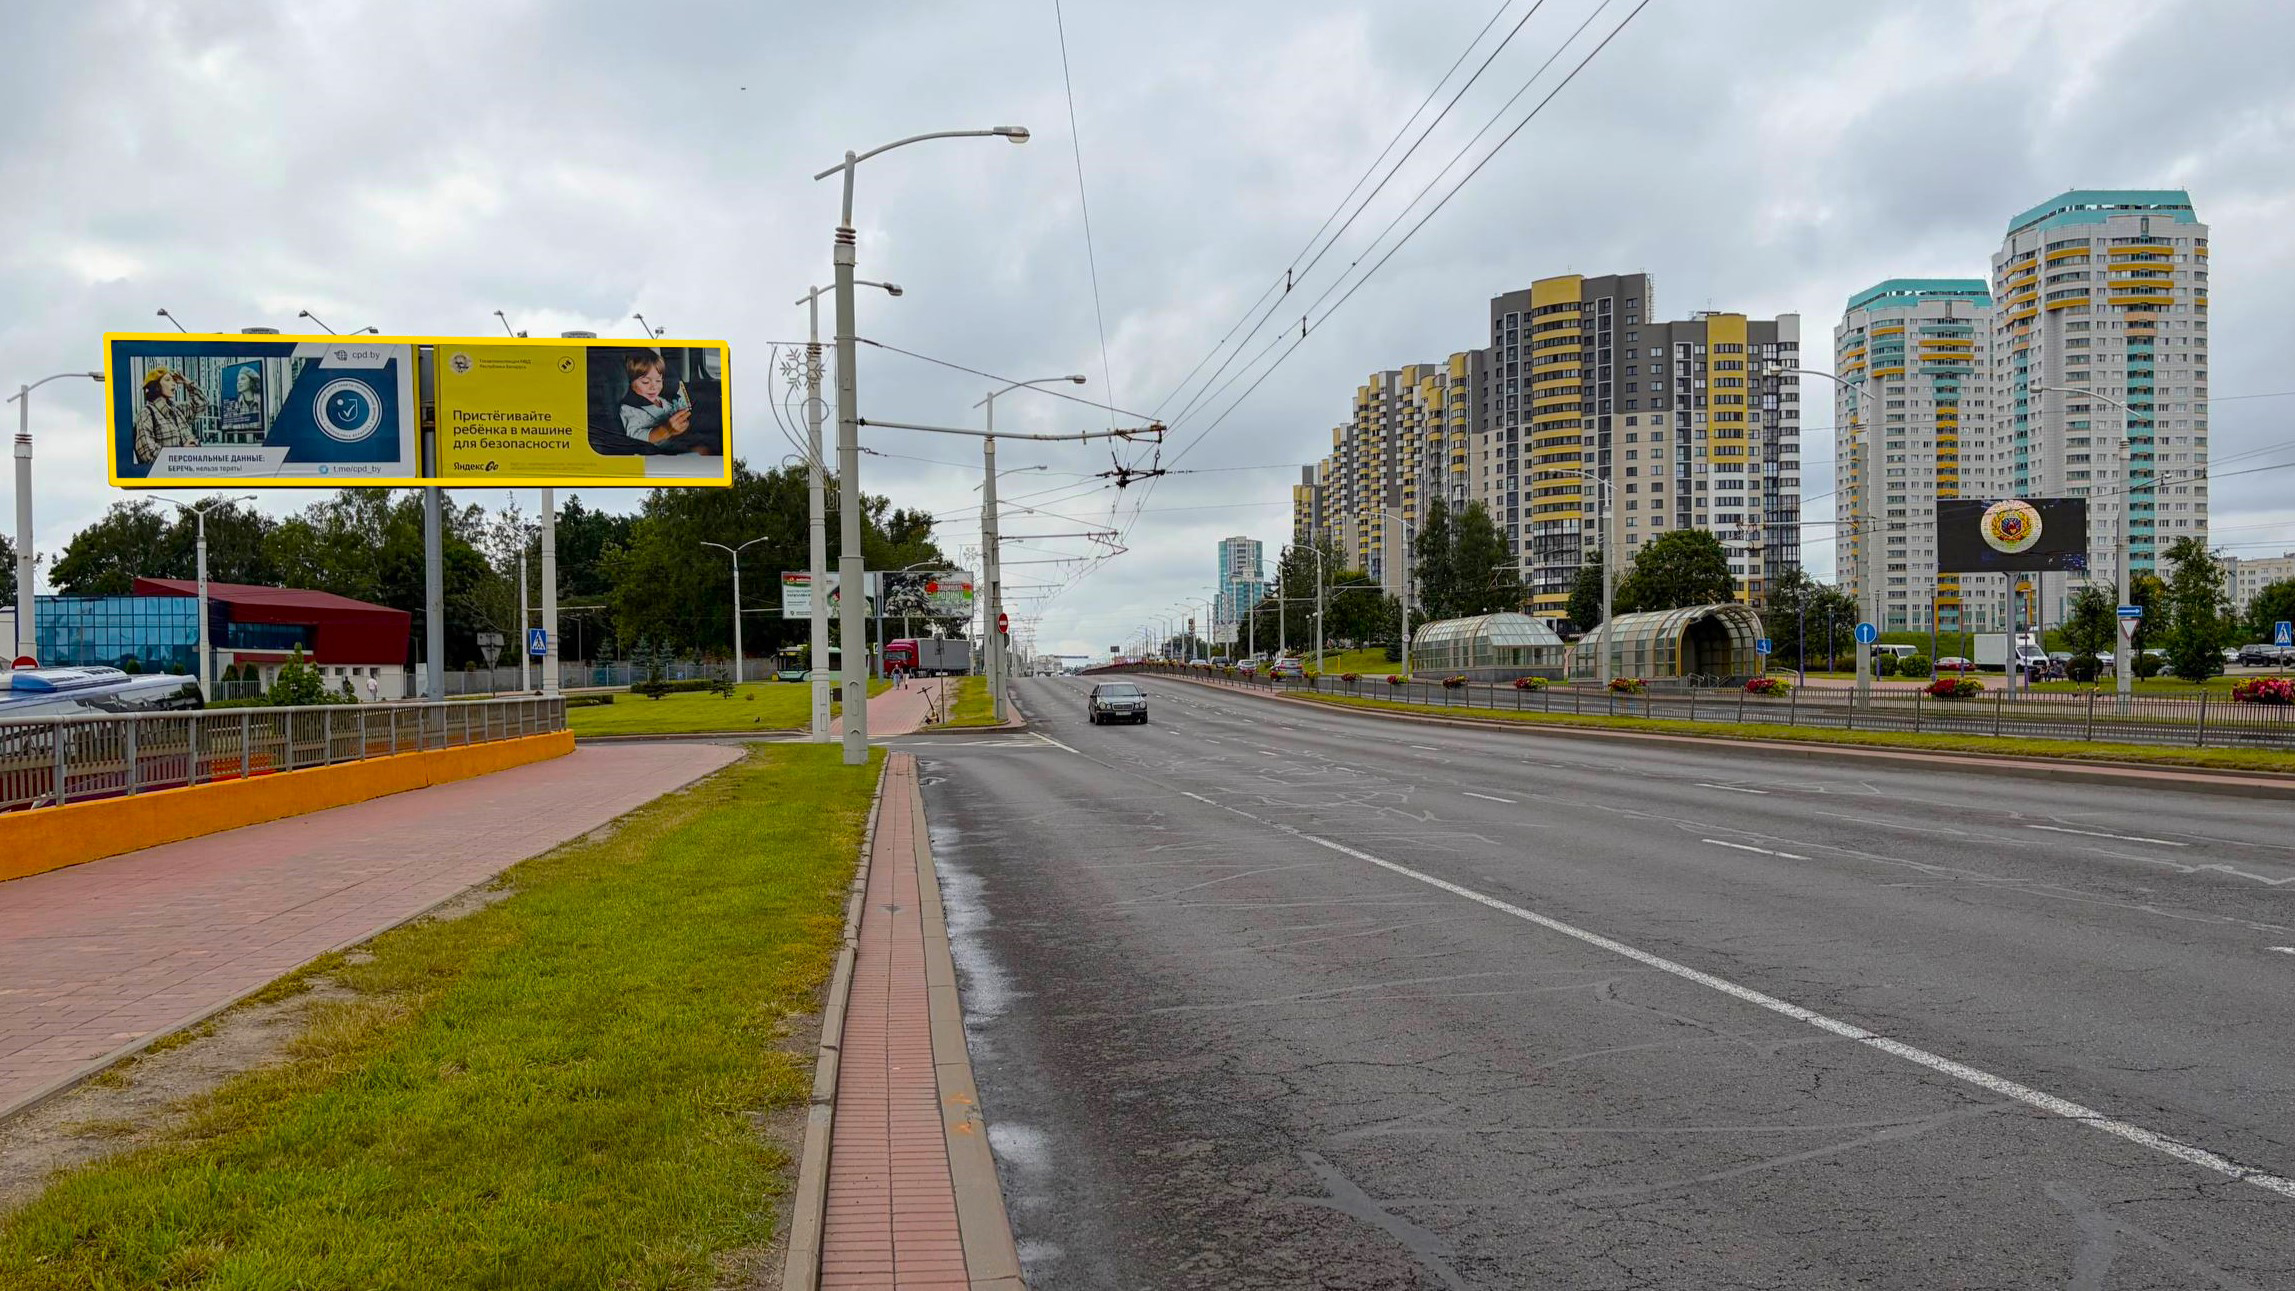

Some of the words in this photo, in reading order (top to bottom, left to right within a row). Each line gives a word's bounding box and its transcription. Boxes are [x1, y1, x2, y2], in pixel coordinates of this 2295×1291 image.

[453, 409, 551, 423] Пристёгивайте
[453, 423, 507, 436] ребёнка
[511, 426, 518, 435] в
[521, 426, 572, 436] машине
[453, 440, 477, 450] для
[480, 438, 570, 449] безопасности
[168, 454, 229, 463] ПЕРСОНАЛЬНЫЕ
[231, 454, 265, 463] ДАННЫЕ:
[333, 465, 381, 474] t.me/cpd_by
[453, 461, 484, 471] Яндекс
[485, 461, 499, 471] Go
[937, 591, 964, 601] РОДИНУ
